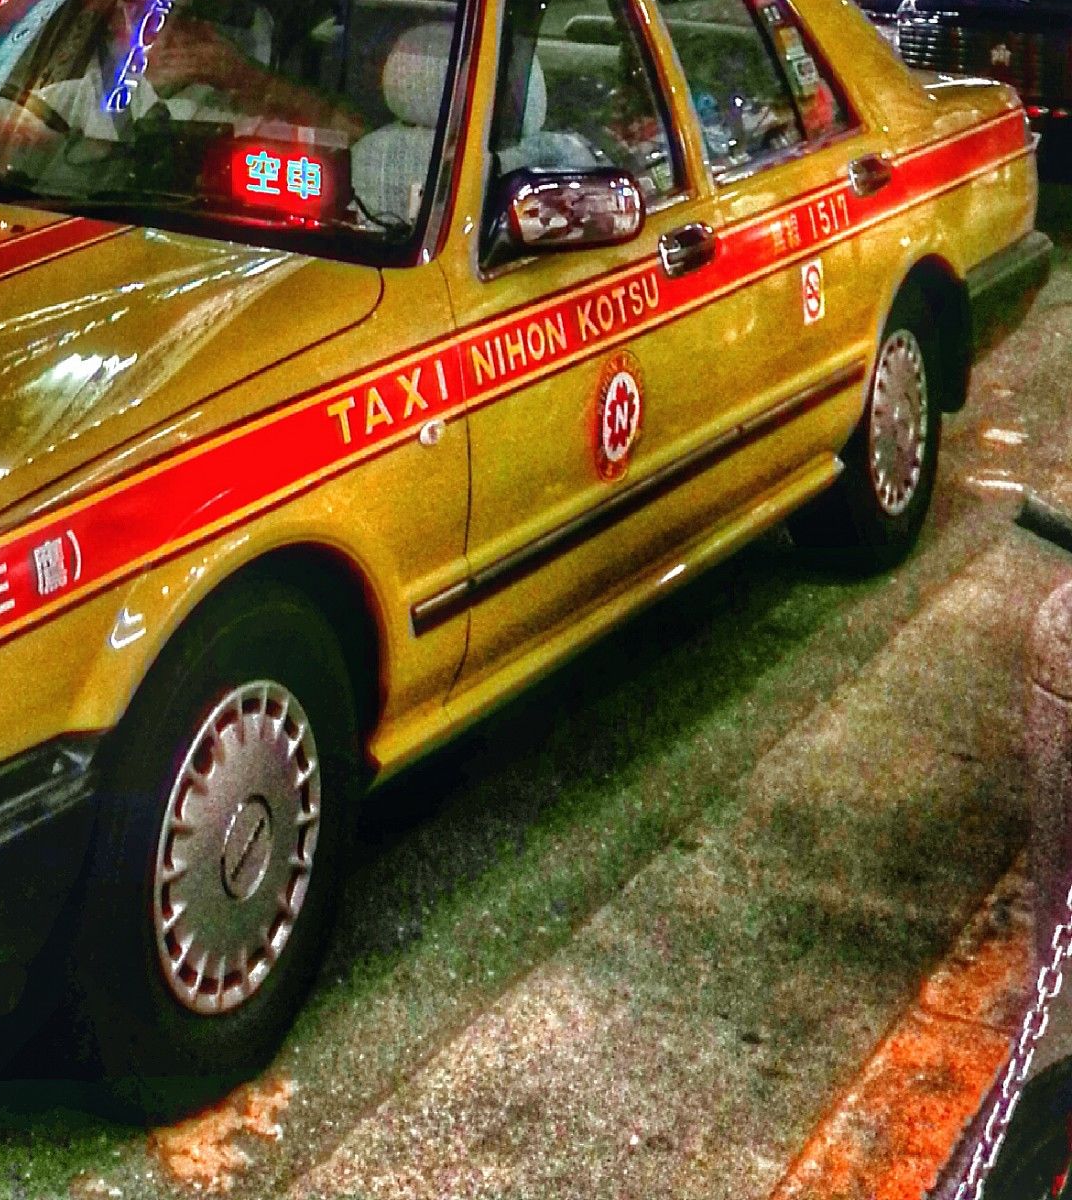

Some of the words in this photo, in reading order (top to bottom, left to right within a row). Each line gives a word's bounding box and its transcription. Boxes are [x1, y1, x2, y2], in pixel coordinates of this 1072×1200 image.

[246, 151, 323, 199] 空車
[808, 194, 850, 240] 1517
[327, 359, 449, 445] TAXI
[470, 312, 568, 386] NIHON
[576, 273, 661, 341] KOTSU
